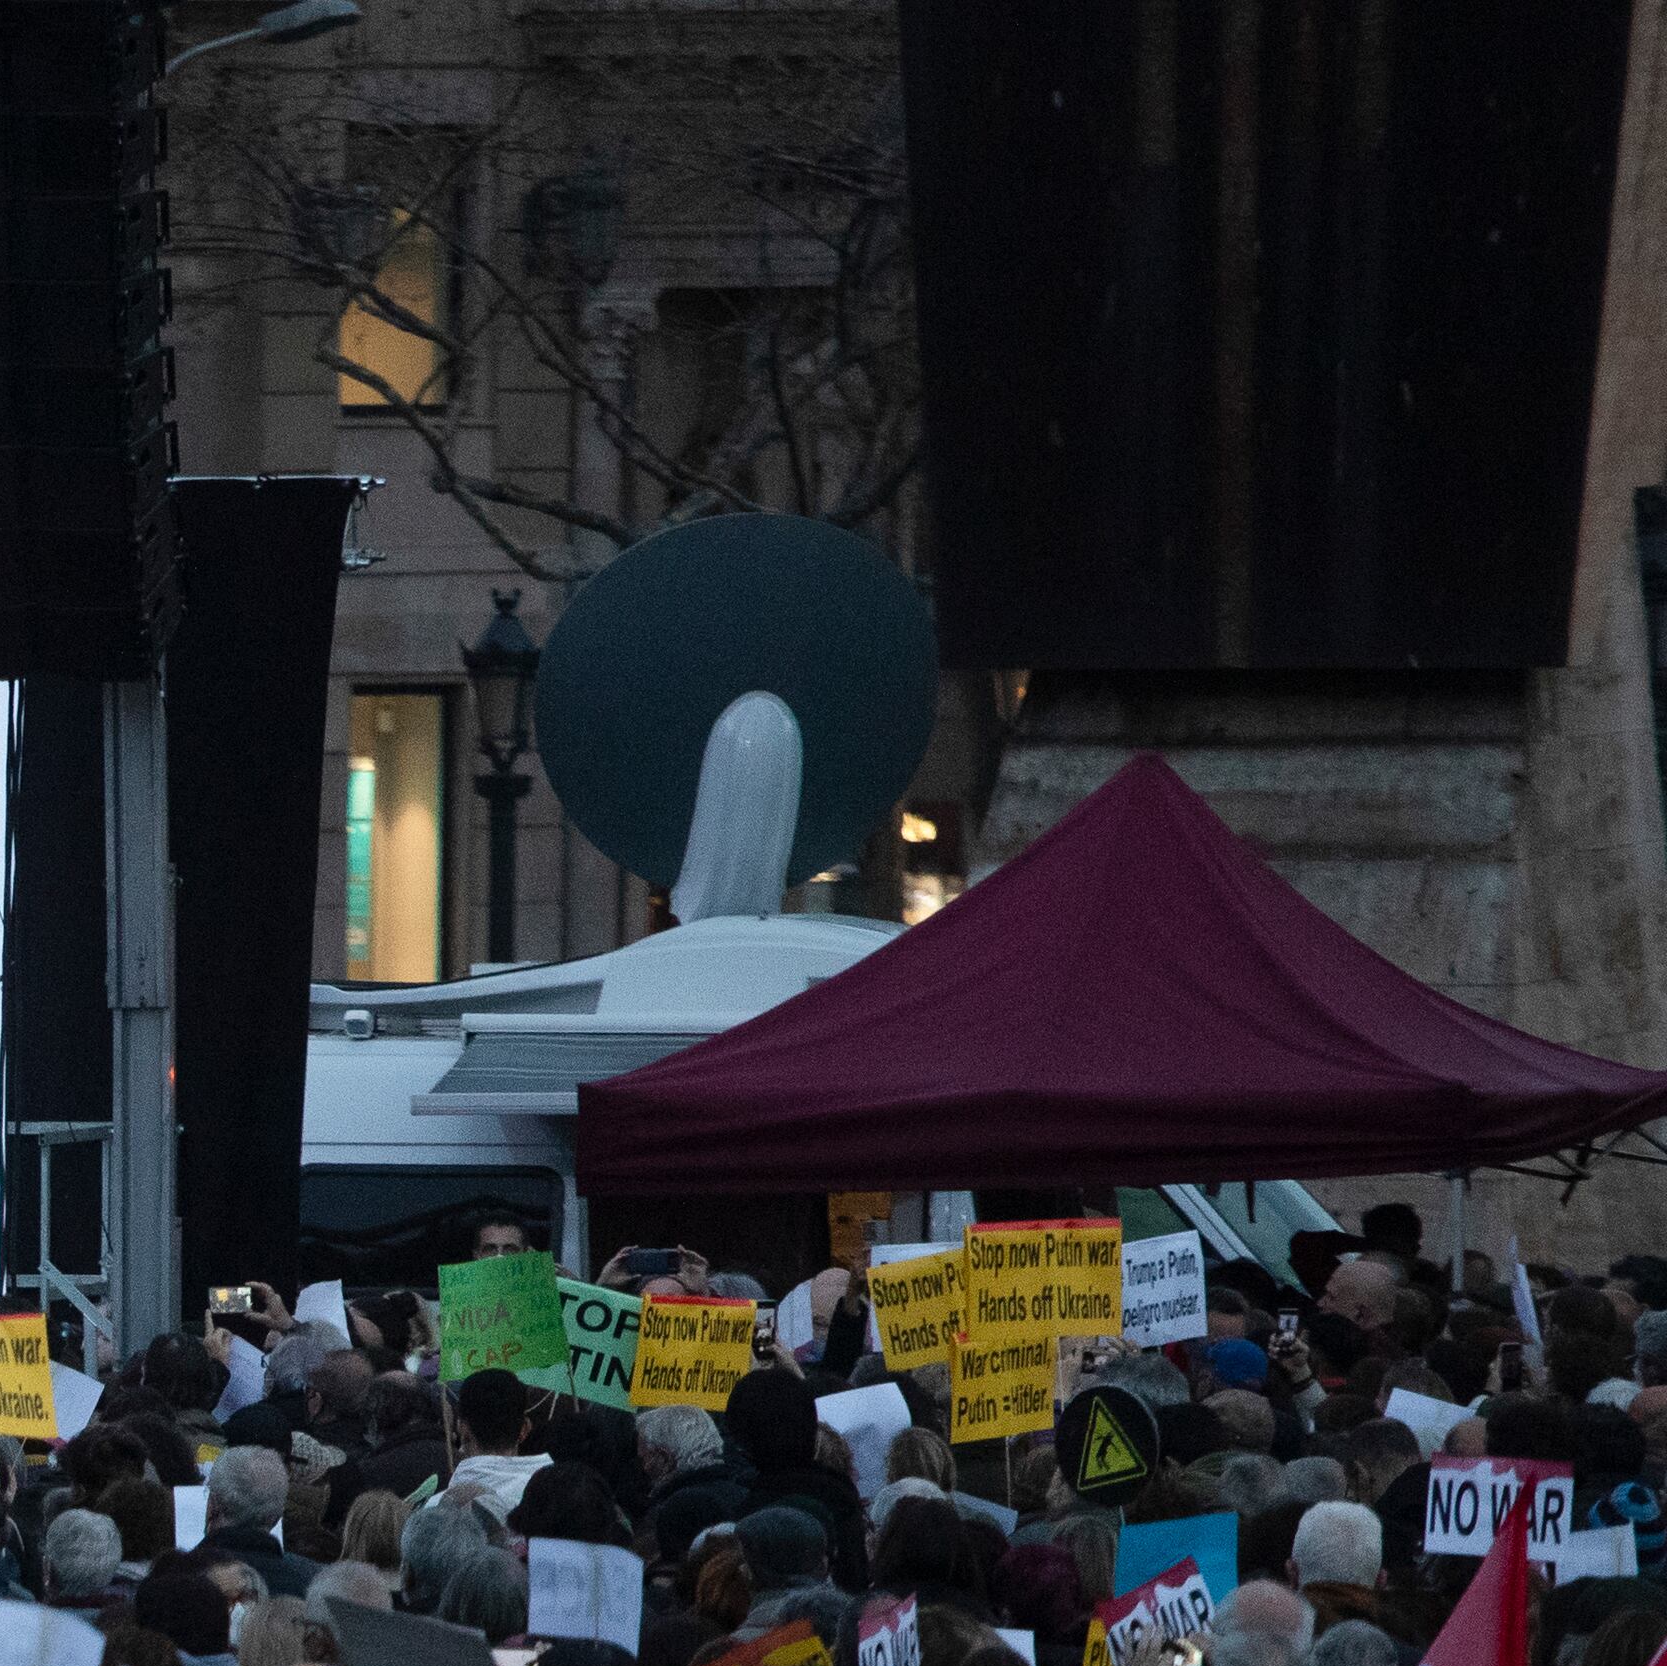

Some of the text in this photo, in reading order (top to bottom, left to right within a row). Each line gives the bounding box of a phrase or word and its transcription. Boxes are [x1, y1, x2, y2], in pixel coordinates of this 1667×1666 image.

[970, 1233, 1120, 1277] Stop now Putin war.
[1125, 1258, 1157, 1287] Trump
[1167, 1250, 1200, 1279] Putin,
[871, 1275, 910, 1312] Stop
[913, 1272, 944, 1300] now
[977, 1284, 1116, 1324] Hands off Ukraine.
[1161, 1292, 1203, 1324] nuclear.
[559, 1293, 640, 1340] OP
[643, 1306, 752, 1348] Stop now Putin war.
[888, 1308, 962, 1357] Hands off
[10, 1334, 47, 1366] war.
[568, 1344, 633, 1393] TIN
[961, 1339, 1053, 1380] War criminal,
[640, 1357, 701, 1393] Hands off
[956, 1397, 998, 1428] Putin
[1429, 1478, 1480, 1537] NO
[1154, 1588, 1210, 1643] WAR
